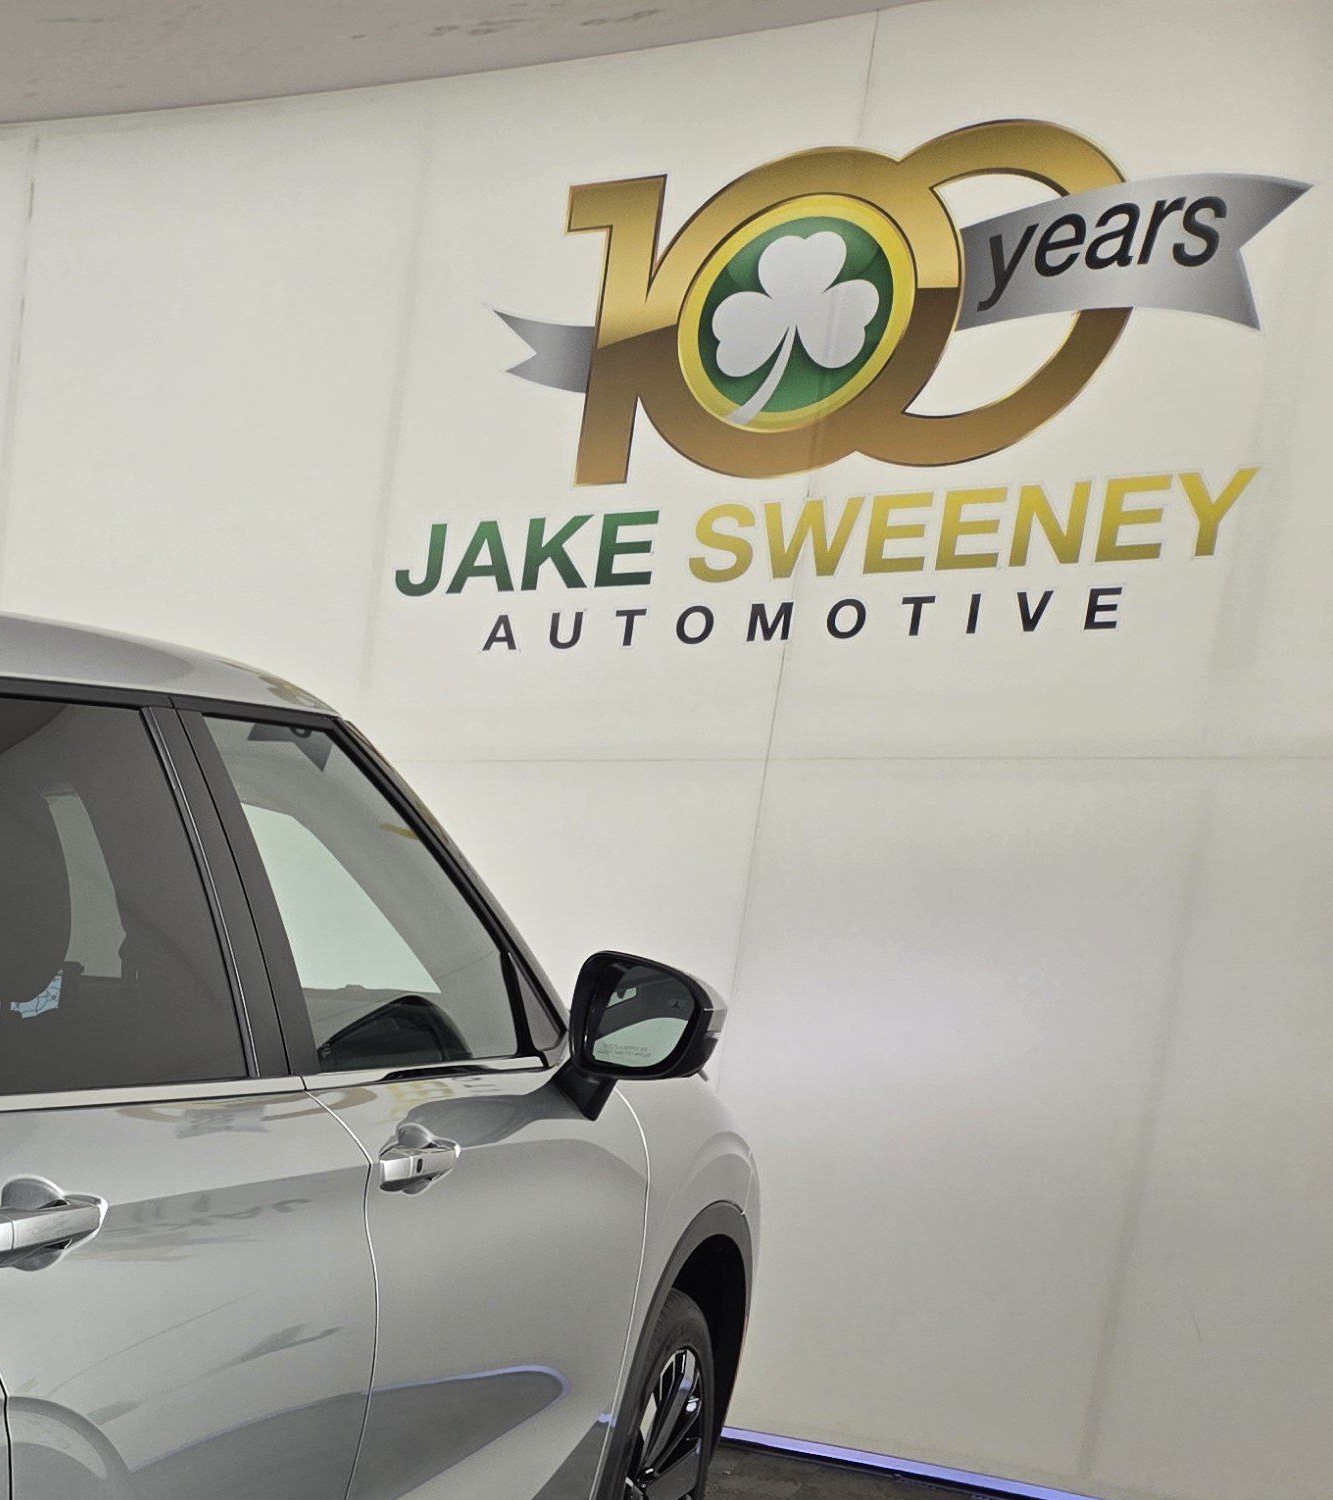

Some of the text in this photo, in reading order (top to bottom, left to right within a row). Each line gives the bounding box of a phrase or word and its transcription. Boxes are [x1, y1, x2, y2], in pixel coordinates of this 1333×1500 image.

[976, 195, 1227, 312] years
[394, 466, 1261, 598] JAKE SWEENEY
[482, 586, 1125, 653] AUTOMOTIVE
